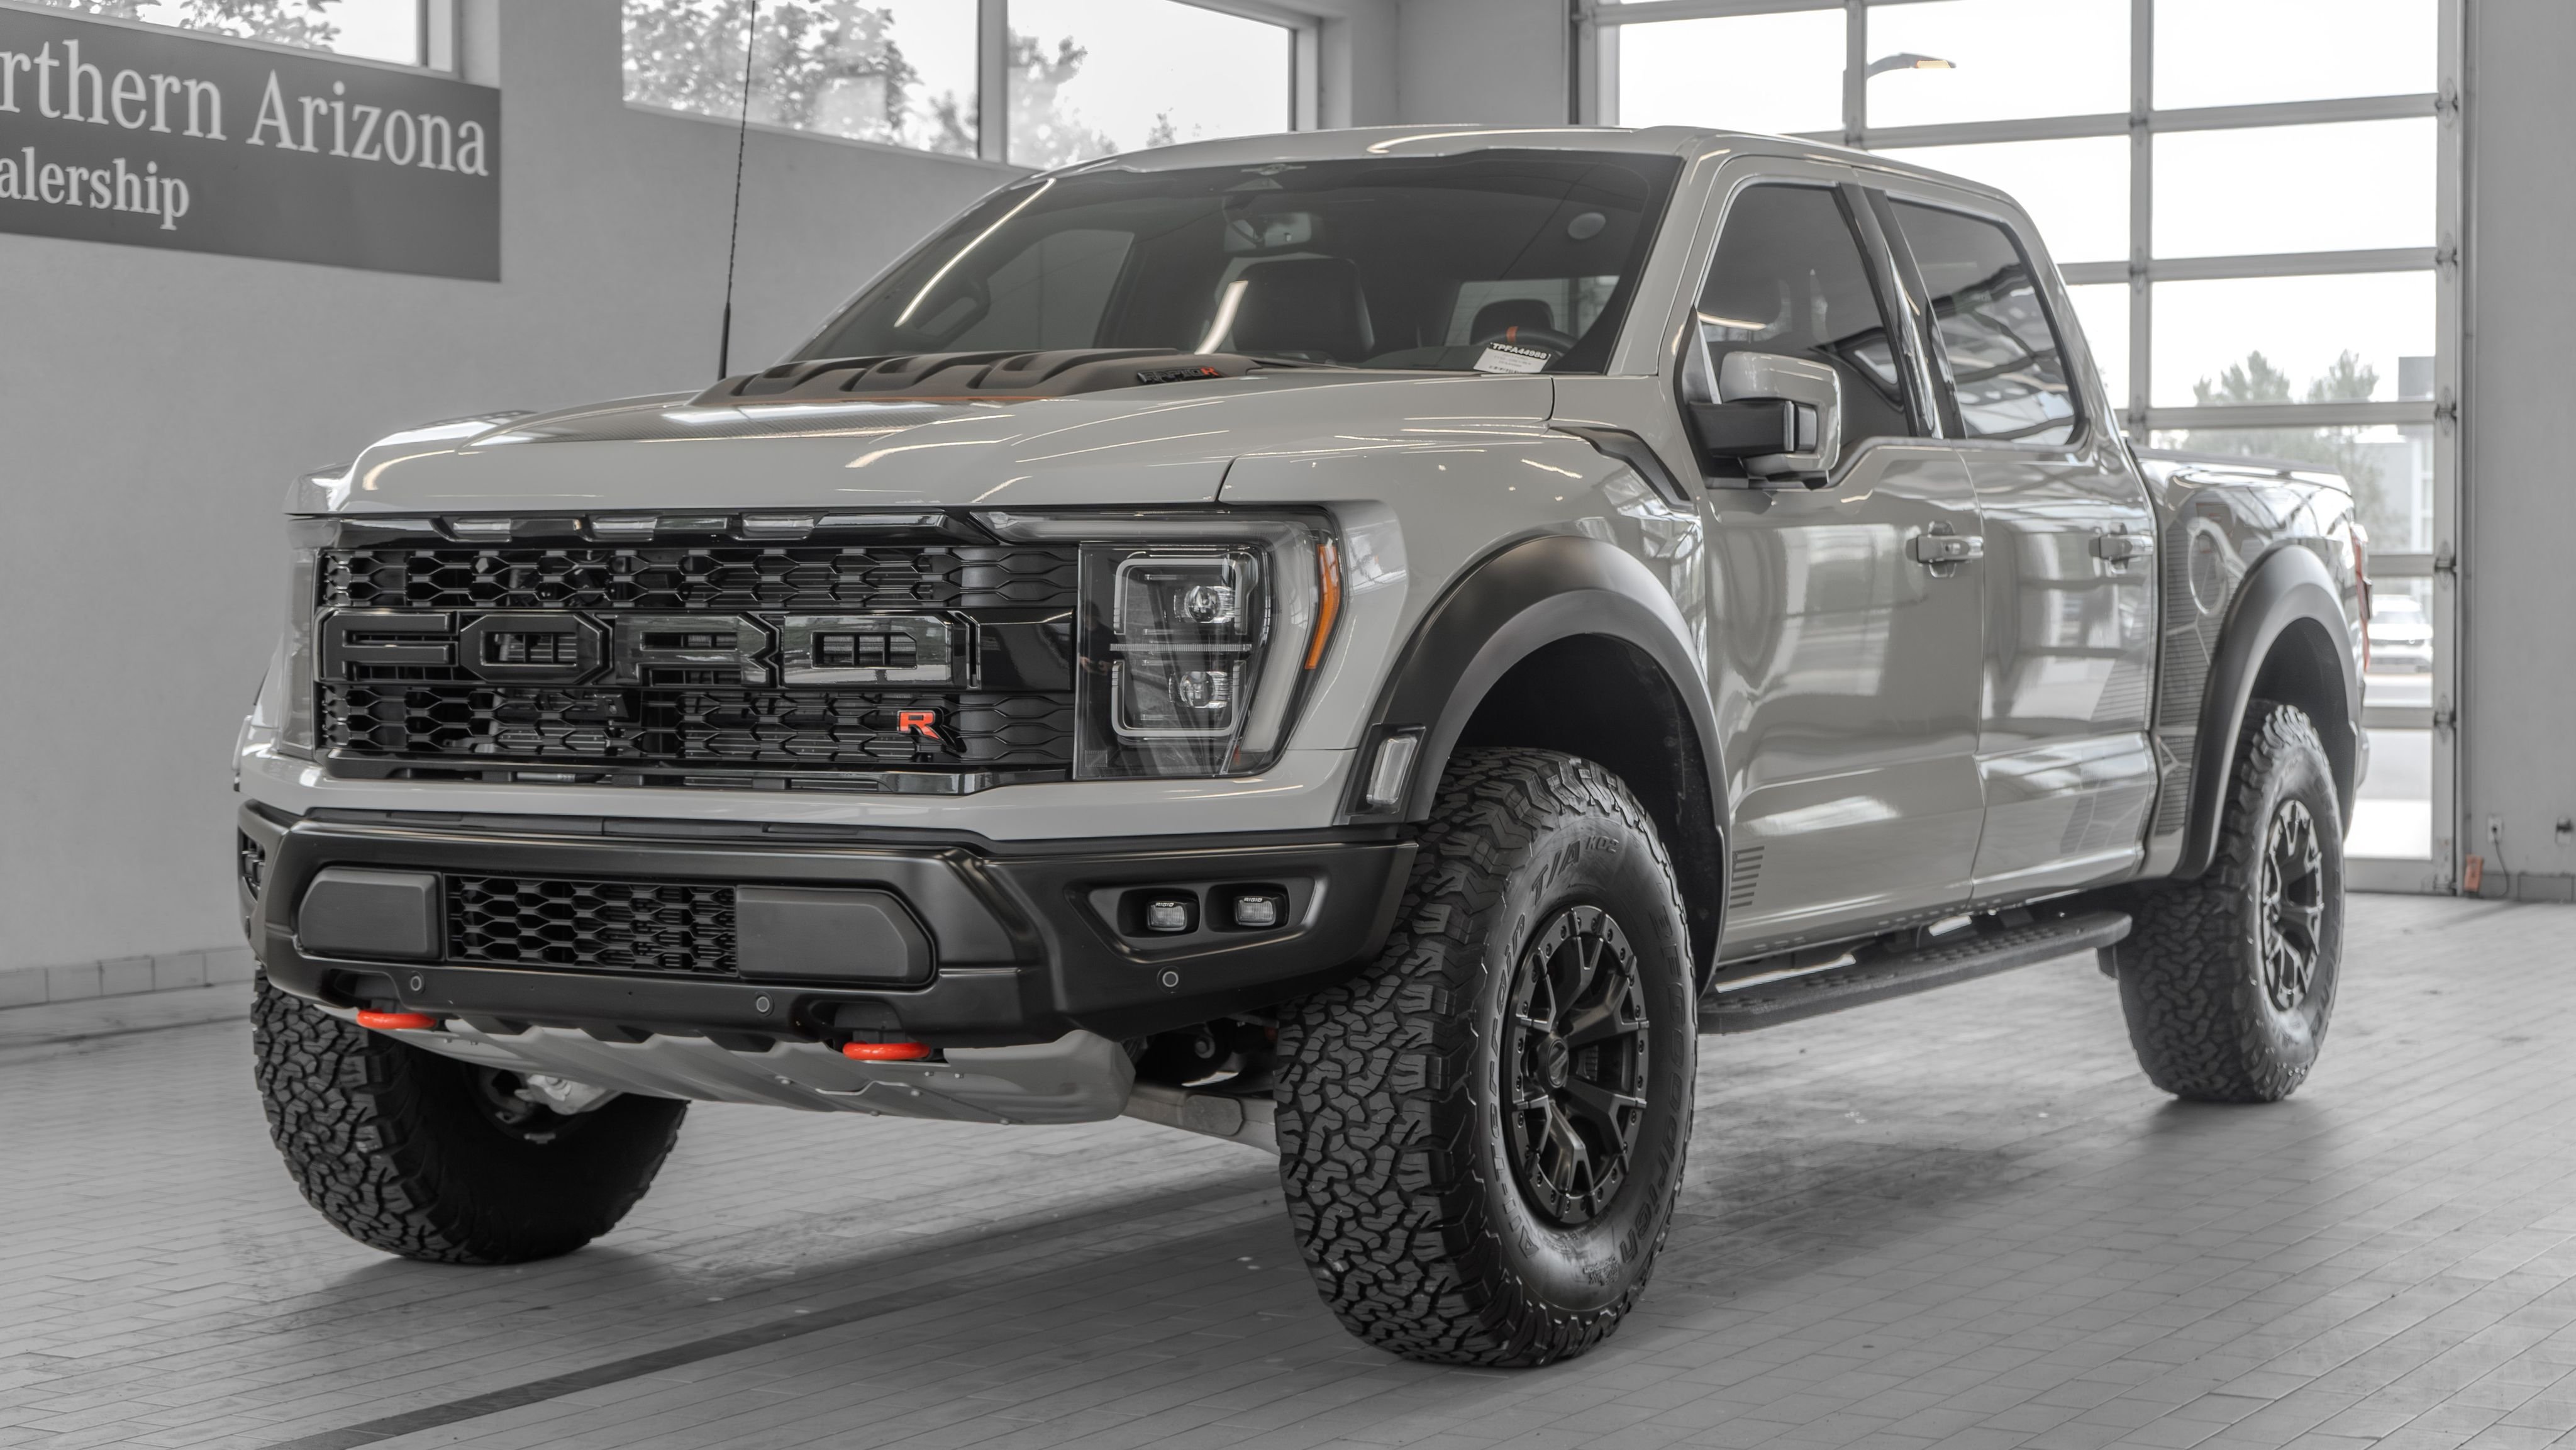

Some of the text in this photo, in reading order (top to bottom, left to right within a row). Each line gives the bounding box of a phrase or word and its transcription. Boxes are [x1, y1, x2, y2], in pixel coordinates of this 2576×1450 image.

[0, 38, 489, 177] rthern Arizona
[0, 145, 190, 231] alership
[319, 610, 958, 689] FORD
[897, 710, 942, 742] R
